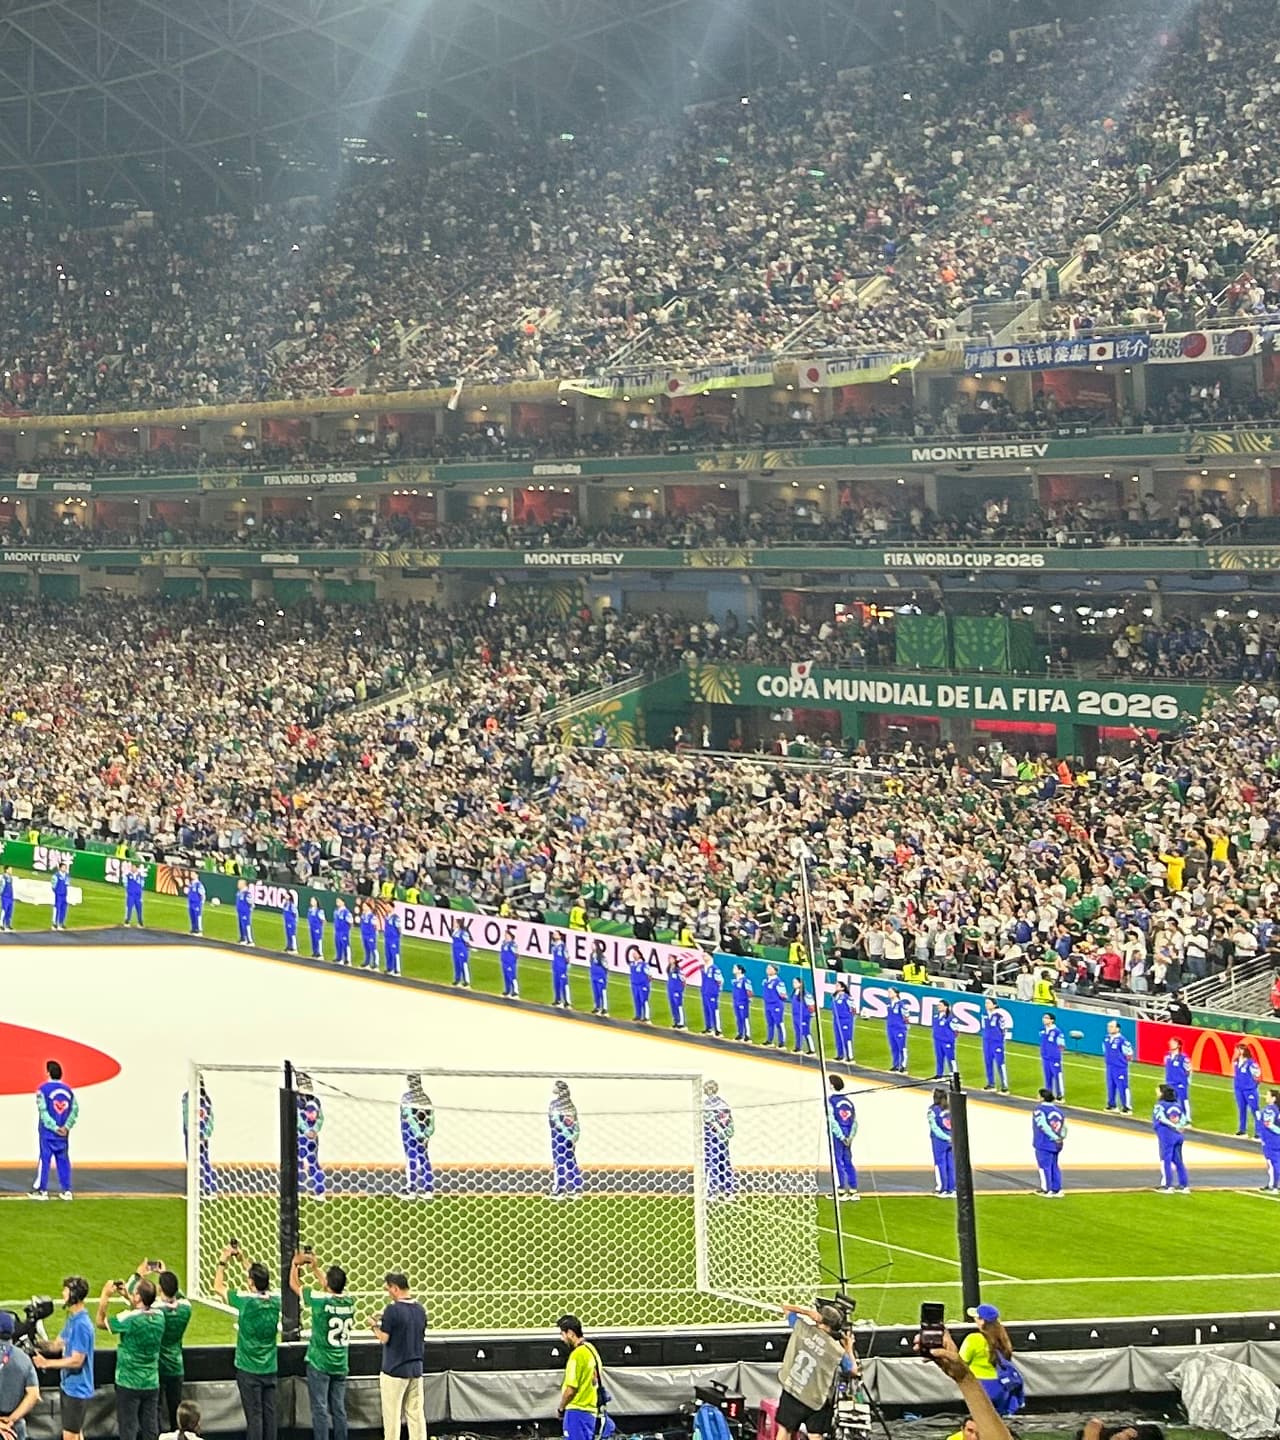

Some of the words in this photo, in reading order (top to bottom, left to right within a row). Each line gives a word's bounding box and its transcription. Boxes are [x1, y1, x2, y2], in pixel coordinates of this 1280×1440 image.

[912, 443, 1049, 461] MONTERREY
[263, 475, 281, 486] FIFA
[281, 474, 310, 485] WORLD
[311, 473, 327, 484] CUP
[4, 552, 81, 563] MONTERREY
[524, 553, 624, 565] MONTERREY
[883, 553, 912, 567] FIFA
[913, 553, 964, 567] WORLD
[964, 553, 991, 567] CUP
[993, 553, 1045, 567] 2026
[757, 674, 819, 700] COPA
[824, 678, 932, 708] MUNDIAL
[937, 684, 970, 709] DE
[974, 686, 1008, 711] LA
[1012, 687, 1071, 714] FIFA
[1077, 690, 1178, 720] 2026
